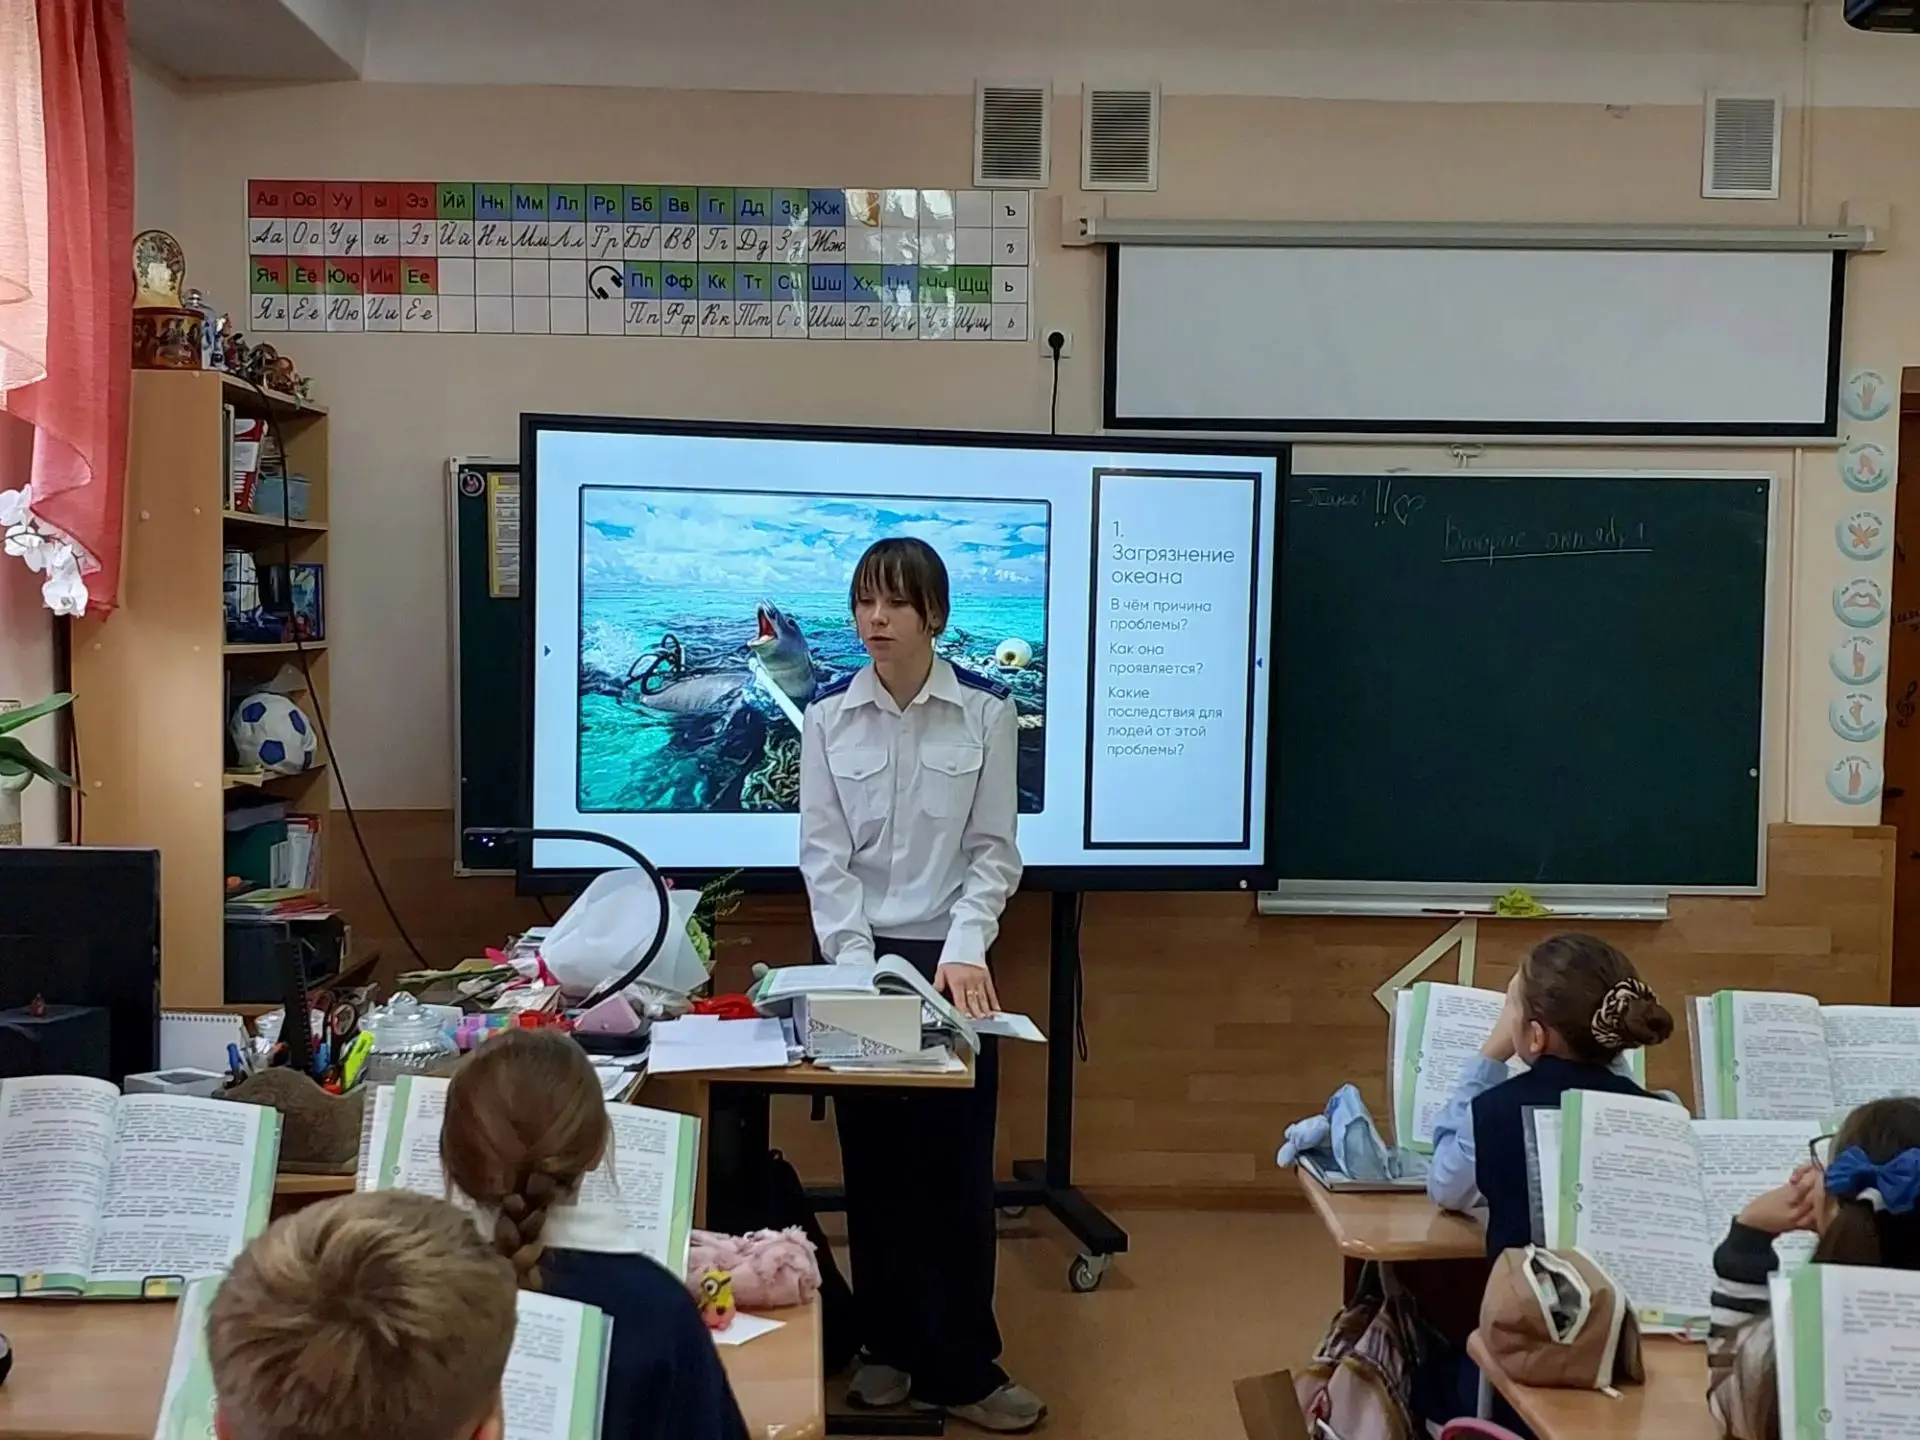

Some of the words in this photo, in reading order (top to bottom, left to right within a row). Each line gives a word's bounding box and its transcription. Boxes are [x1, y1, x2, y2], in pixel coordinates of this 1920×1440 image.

[257, 192, 279, 206] Аа
[293, 192, 317, 206] Оо
[332, 193, 353, 211] Уу
[407, 193, 428, 208] Ээ
[443, 190, 466, 208] Йй
[481, 195, 503, 209] Нн
[516, 196, 543, 210] Мм
[555, 196, 578, 210] Лл
[594, 196, 616, 214] Рр
[631, 196, 652, 211] Бб
[668, 198, 689, 212] Вв
[709, 199, 726, 214] Гг
[741, 200, 764, 216] Дд
[812, 200, 840, 215] Жж
[252, 221, 283, 244] Аа
[293, 222, 319, 244] Оо
[329, 222, 358, 254] Уу
[477, 225, 509, 246] Нн
[592, 225, 619, 258] Рр
[624, 226, 660, 248] Бб
[664, 227, 695, 249] Вв
[737, 228, 769, 260] Дд
[257, 268, 279, 282] Яя
[328, 268, 359, 283] Юю
[370, 269, 393, 283] Ии
[631, 273, 653, 288] Пп
[665, 274, 693, 291] Фф
[708, 275, 728, 289] Кк
[743, 275, 763, 289] Тт
[812, 276, 842, 291] Шш
[958, 276, 988, 296] Щщ
[254, 298, 286, 319] Яя
[327, 298, 359, 320] Юю
[367, 298, 399, 319] Ии
[626, 302, 659, 324] Пп
[664, 303, 695, 335] Фф
[701, 304, 730, 325] Кк
[808, 306, 845, 327] Шш
[1112, 520, 1124, 538] 1.
[1112, 543, 1235, 564] Загрязнение
[1111, 570, 1182, 584] океана
[1111, 598, 1120, 611] В
[1123, 600, 1149, 611] чём
[1153, 601, 1212, 613] причина
[1110, 618, 1188, 631] проблемы?
[1109, 642, 1134, 655] Как
[1137, 645, 1164, 655] она
[1108, 662, 1204, 676] проявляется?
[1108, 686, 1150, 699] Какие
[1107, 707, 1195, 719] последствия
[1198, 708, 1223, 720] для
[1106, 725, 1153, 738] людей
[1156, 727, 1171, 737] от
[1174, 726, 1206, 737] этой
[1106, 743, 1185, 757] проблемы?
